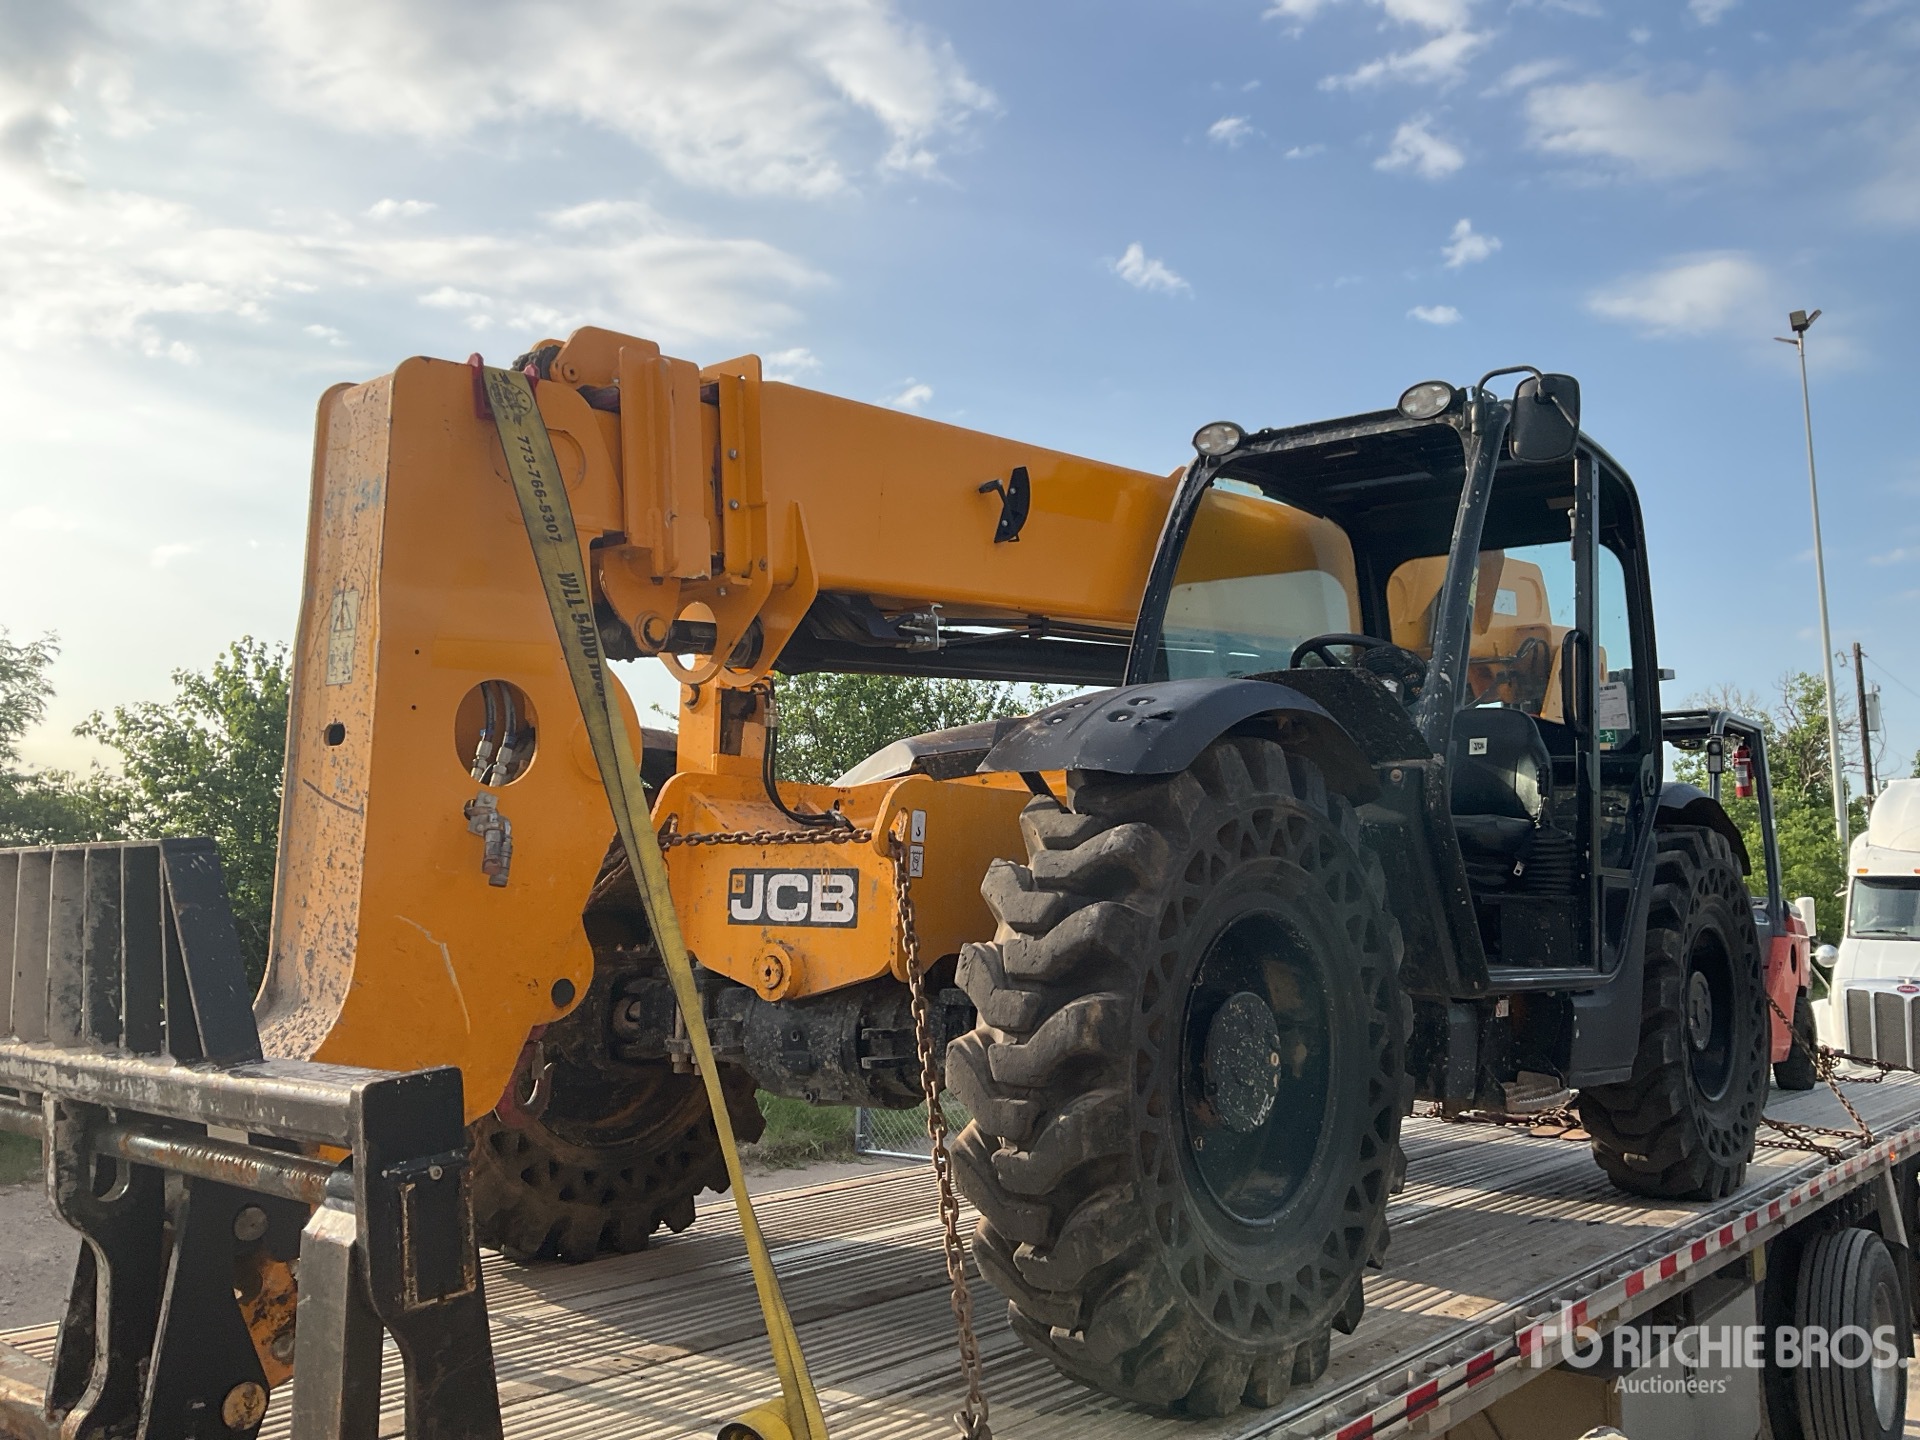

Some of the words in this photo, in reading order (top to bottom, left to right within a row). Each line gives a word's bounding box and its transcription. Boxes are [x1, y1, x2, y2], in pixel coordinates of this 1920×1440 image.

[516, 434, 563, 543] 773-766-5307
[557, 571, 585, 608] WLL
[731, 873, 855, 923] JCB
